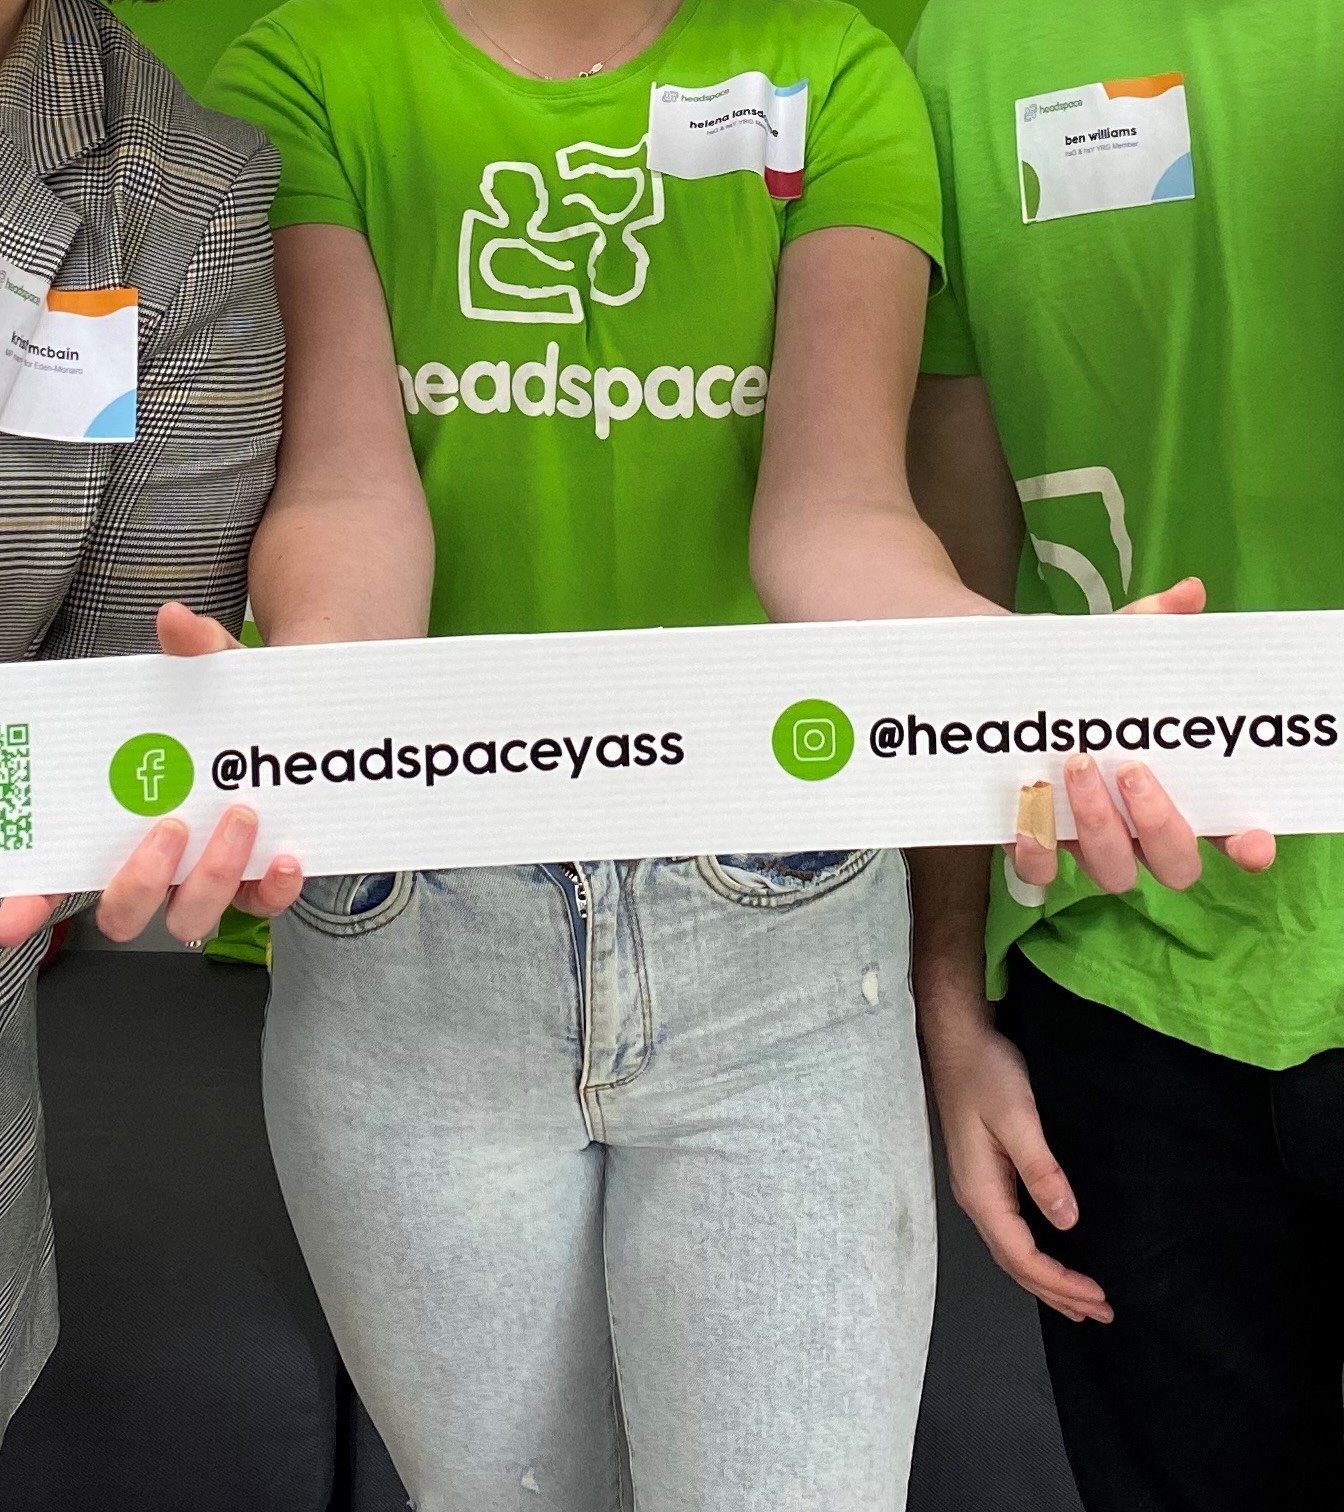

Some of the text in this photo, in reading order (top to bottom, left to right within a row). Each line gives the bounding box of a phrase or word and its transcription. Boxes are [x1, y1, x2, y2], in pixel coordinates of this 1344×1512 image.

[681, 89, 729, 102] headspace
[1039, 100, 1082, 114] headspace
[690, 115, 729, 129] helena
[1065, 127, 1137, 145] ben williams
[28, 346, 79, 360] mcbain
[869, 709, 1339, 759] @headspaceyass
[212, 726, 685, 792] @headspaceyass
